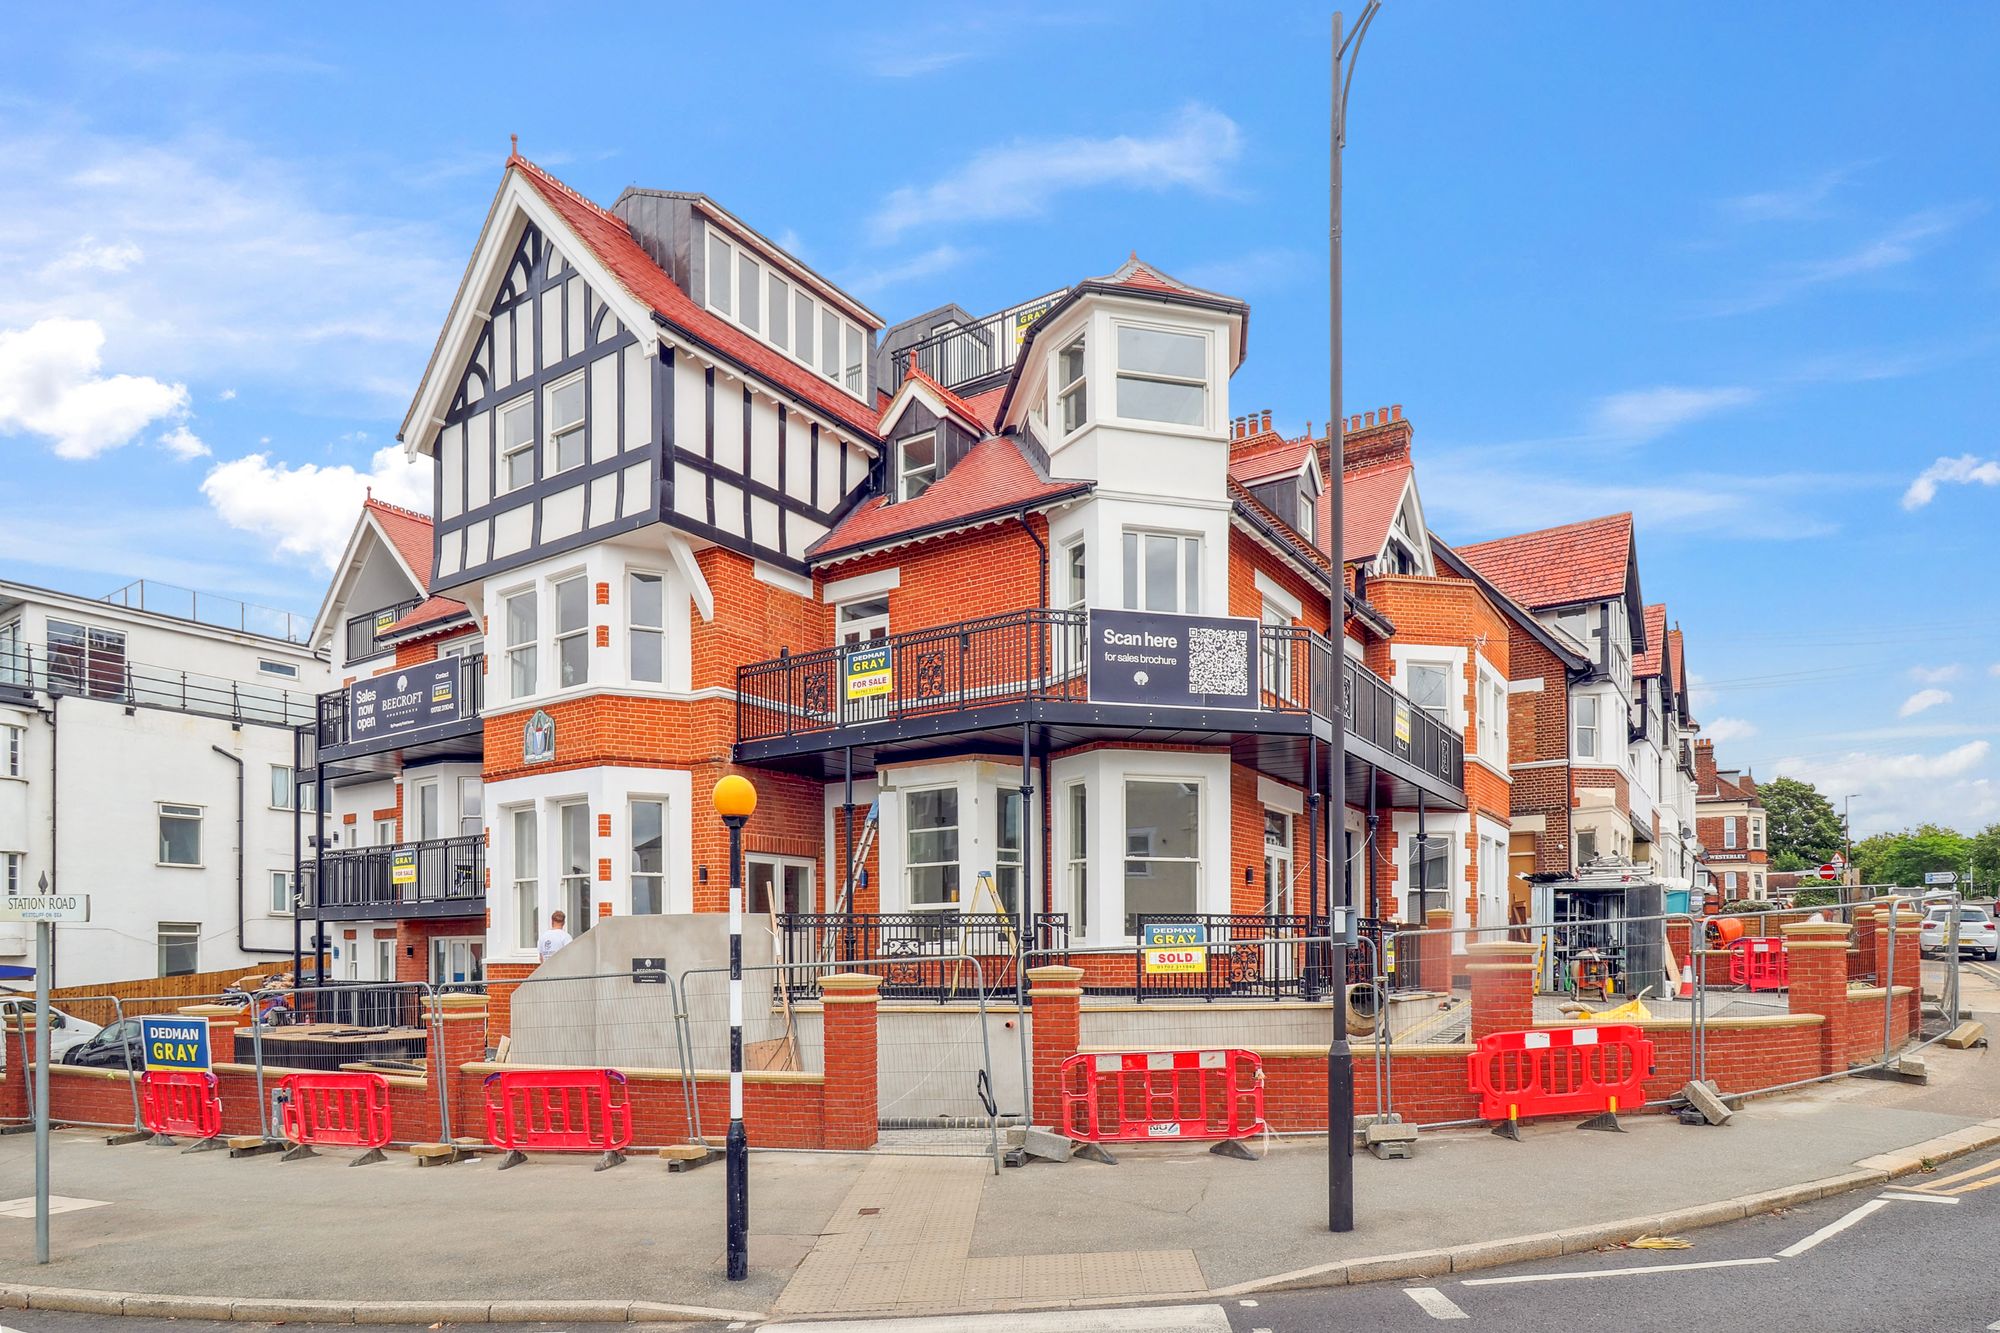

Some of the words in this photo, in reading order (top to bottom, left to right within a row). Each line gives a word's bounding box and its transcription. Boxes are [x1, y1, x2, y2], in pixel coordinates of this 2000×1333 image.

[1020, 304, 1046, 316] DEDMAN
[1020, 309, 1046, 323] GRAY
[379, 616, 392, 625] GRAY
[1104, 629, 1141, 646] Scan
[1144, 631, 1178, 648] here
[853, 651, 885, 662] DEDMAN
[1105, 651, 1116, 662] for
[1117, 653, 1139, 663] sales
[1140, 653, 1177, 666] brochure
[853, 658, 885, 671] GRAY
[853, 681, 867, 689] FOR
[868, 677, 887, 686] SALE
[356, 689, 376, 704] Sales
[382, 692, 423, 711] BEECROFT
[358, 703, 374, 717] now
[356, 716, 376, 732] open
[395, 856, 412, 864] GRAY
[8, 897, 45, 910] STATION
[49, 897, 76, 910] ROAD
[1153, 934, 1196, 944] GRAY
[1158, 953, 1193, 963] SOLD
[150, 1027, 199, 1040] DEDMAN
[153, 1042, 198, 1062] GRAY
